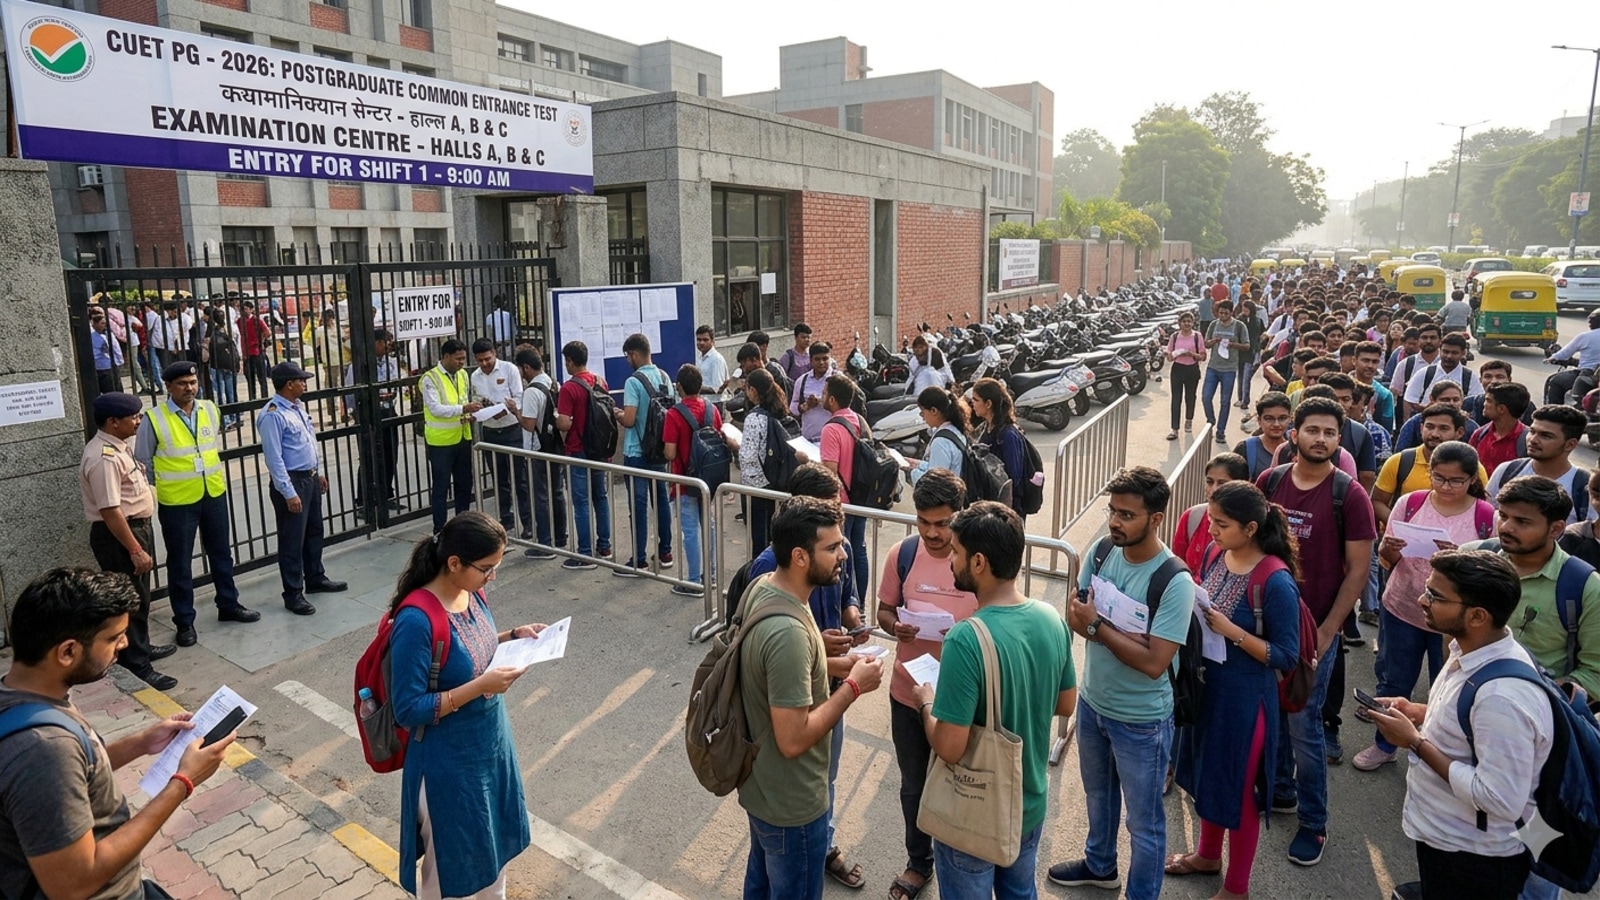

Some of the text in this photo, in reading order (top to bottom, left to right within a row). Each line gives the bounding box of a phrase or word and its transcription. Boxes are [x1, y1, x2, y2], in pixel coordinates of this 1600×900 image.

[106, 29, 164, 59] CUET
[172, 41, 200, 66] PG
[221, 50, 275, 77] 2026:
[281, 60, 404, 97] POSTGRADUATE
[408, 82, 468, 108] COMMON
[472, 94, 530, 118] ENTRANCE
[534, 104, 557, 122] TEST
[151, 105, 326, 145] EXAMINATION
[333, 126, 411, 153] CENTRE
[431, 137, 482, 160] HALLS
[487, 144, 502, 164] A,
[507, 146, 516, 163] B
[521, 148, 531, 165] &
[536, 150, 545, 166] C
[451, 115, 465, 135] A,
[470, 118, 479, 133] B
[484, 120, 494, 136] &
[499, 122, 508, 137] C
[228, 148, 303, 173] ENTRY
[311, 155, 353, 177] FOR
[359, 159, 413, 181] SHIFT
[419, 165, 427, 181] 1
[447, 167, 482, 185] 9:00
[487, 170, 510, 187] AM
[398, 293, 451, 313] ENTRY FOR
